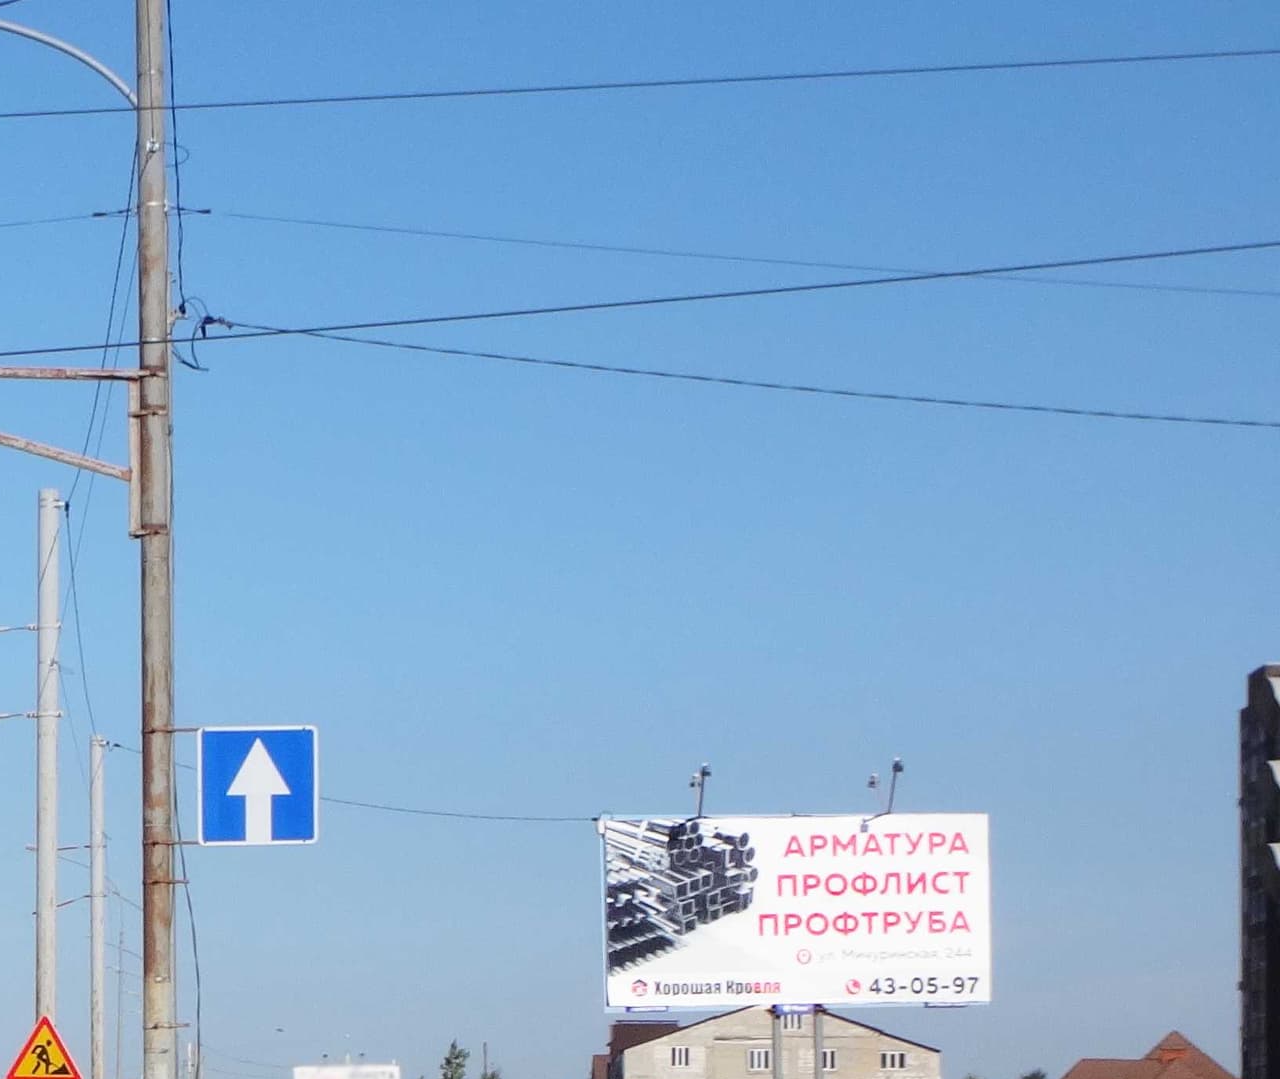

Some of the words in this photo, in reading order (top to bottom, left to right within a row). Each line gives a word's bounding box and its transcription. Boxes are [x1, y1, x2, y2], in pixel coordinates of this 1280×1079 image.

[783, 832, 970, 857] АРМАТУРА
[777, 871, 971, 897] ПРОФЛИСТ
[758, 911, 972, 936] ПРОФТРУБА
[654, 981, 722, 995] Хорошая
[726, 980, 781, 995] Кровля
[869, 976, 979, 995] 43-05-97
